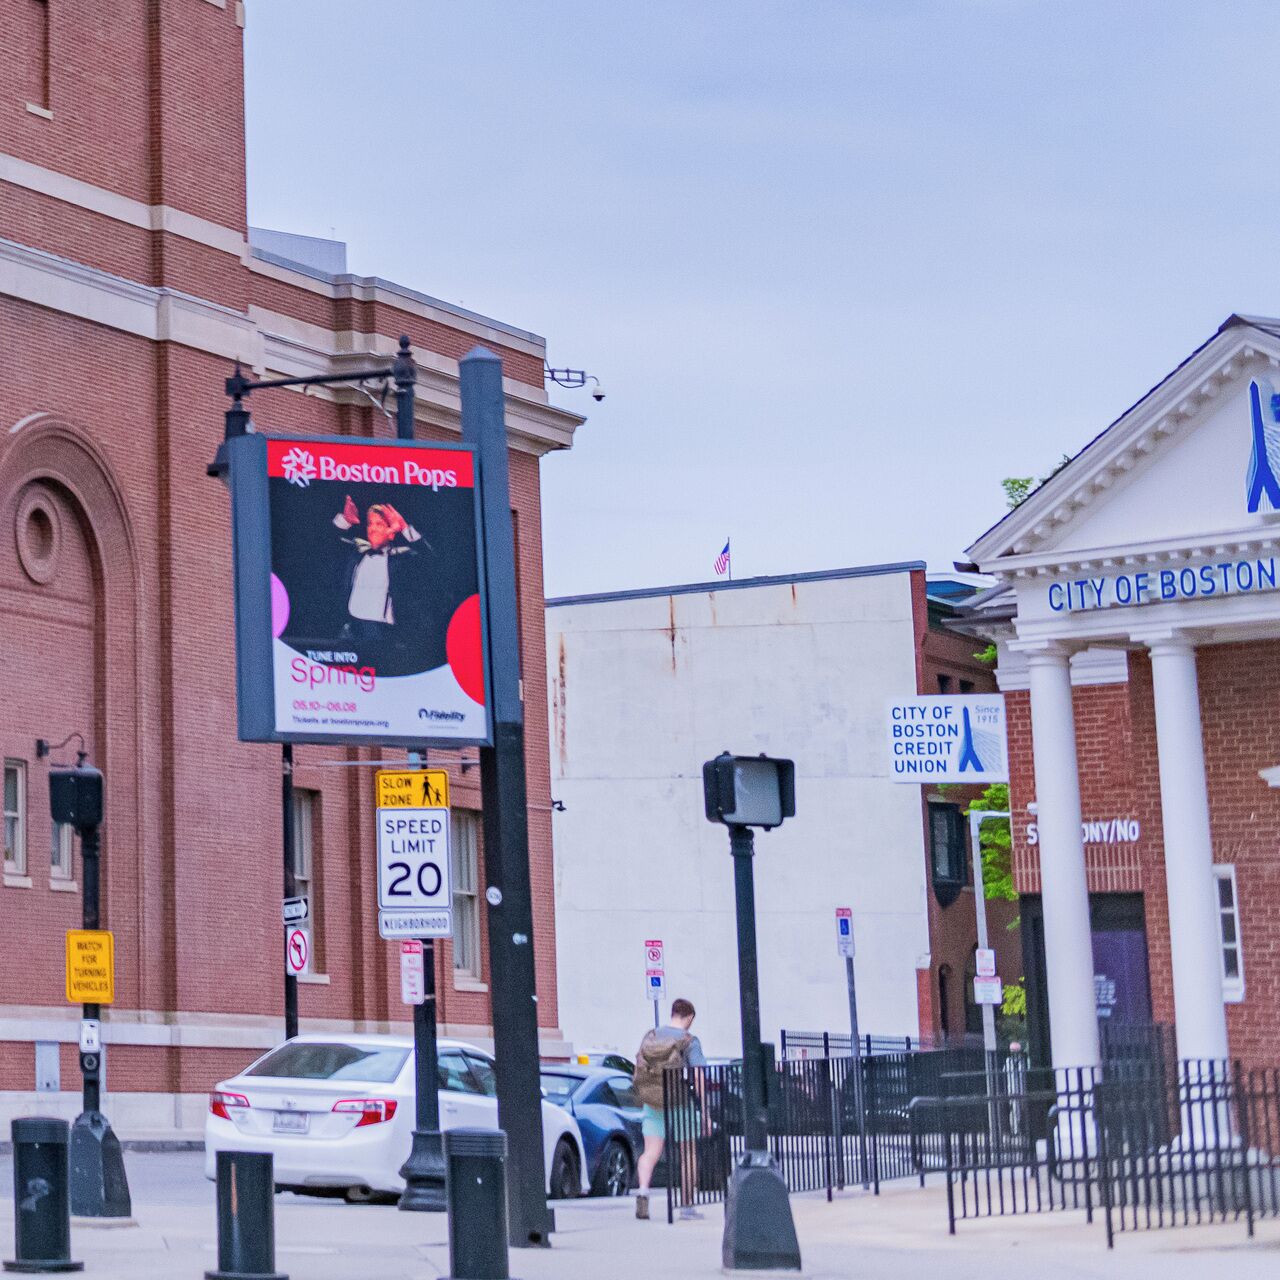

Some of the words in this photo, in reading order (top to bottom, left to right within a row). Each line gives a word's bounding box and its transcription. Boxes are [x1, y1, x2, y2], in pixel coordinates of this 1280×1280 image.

[319, 456, 400, 484] Boston
[403, 461, 458, 493] Pops
[1048, 577, 1105, 611] CITY
[1115, 573, 1149, 604] OF
[1159, 557, 1276, 600] BOSTON
[306, 650, 333, 663] TUNE
[291, 658, 377, 692] Spring
[892, 706, 927, 720] CITY
[932, 706, 953, 720] OF
[975, 705, 1000, 714] Since
[893, 724, 959, 738] BOSTON
[894, 741, 953, 756] CREDIT
[895, 760, 947, 773] UNION
[383, 778, 413, 790] SLOW
[383, 794, 413, 806] ZONE
[385, 819, 442, 835] SPEED
[391, 839, 436, 854] LIMIT
[388, 862, 442, 896] 20
